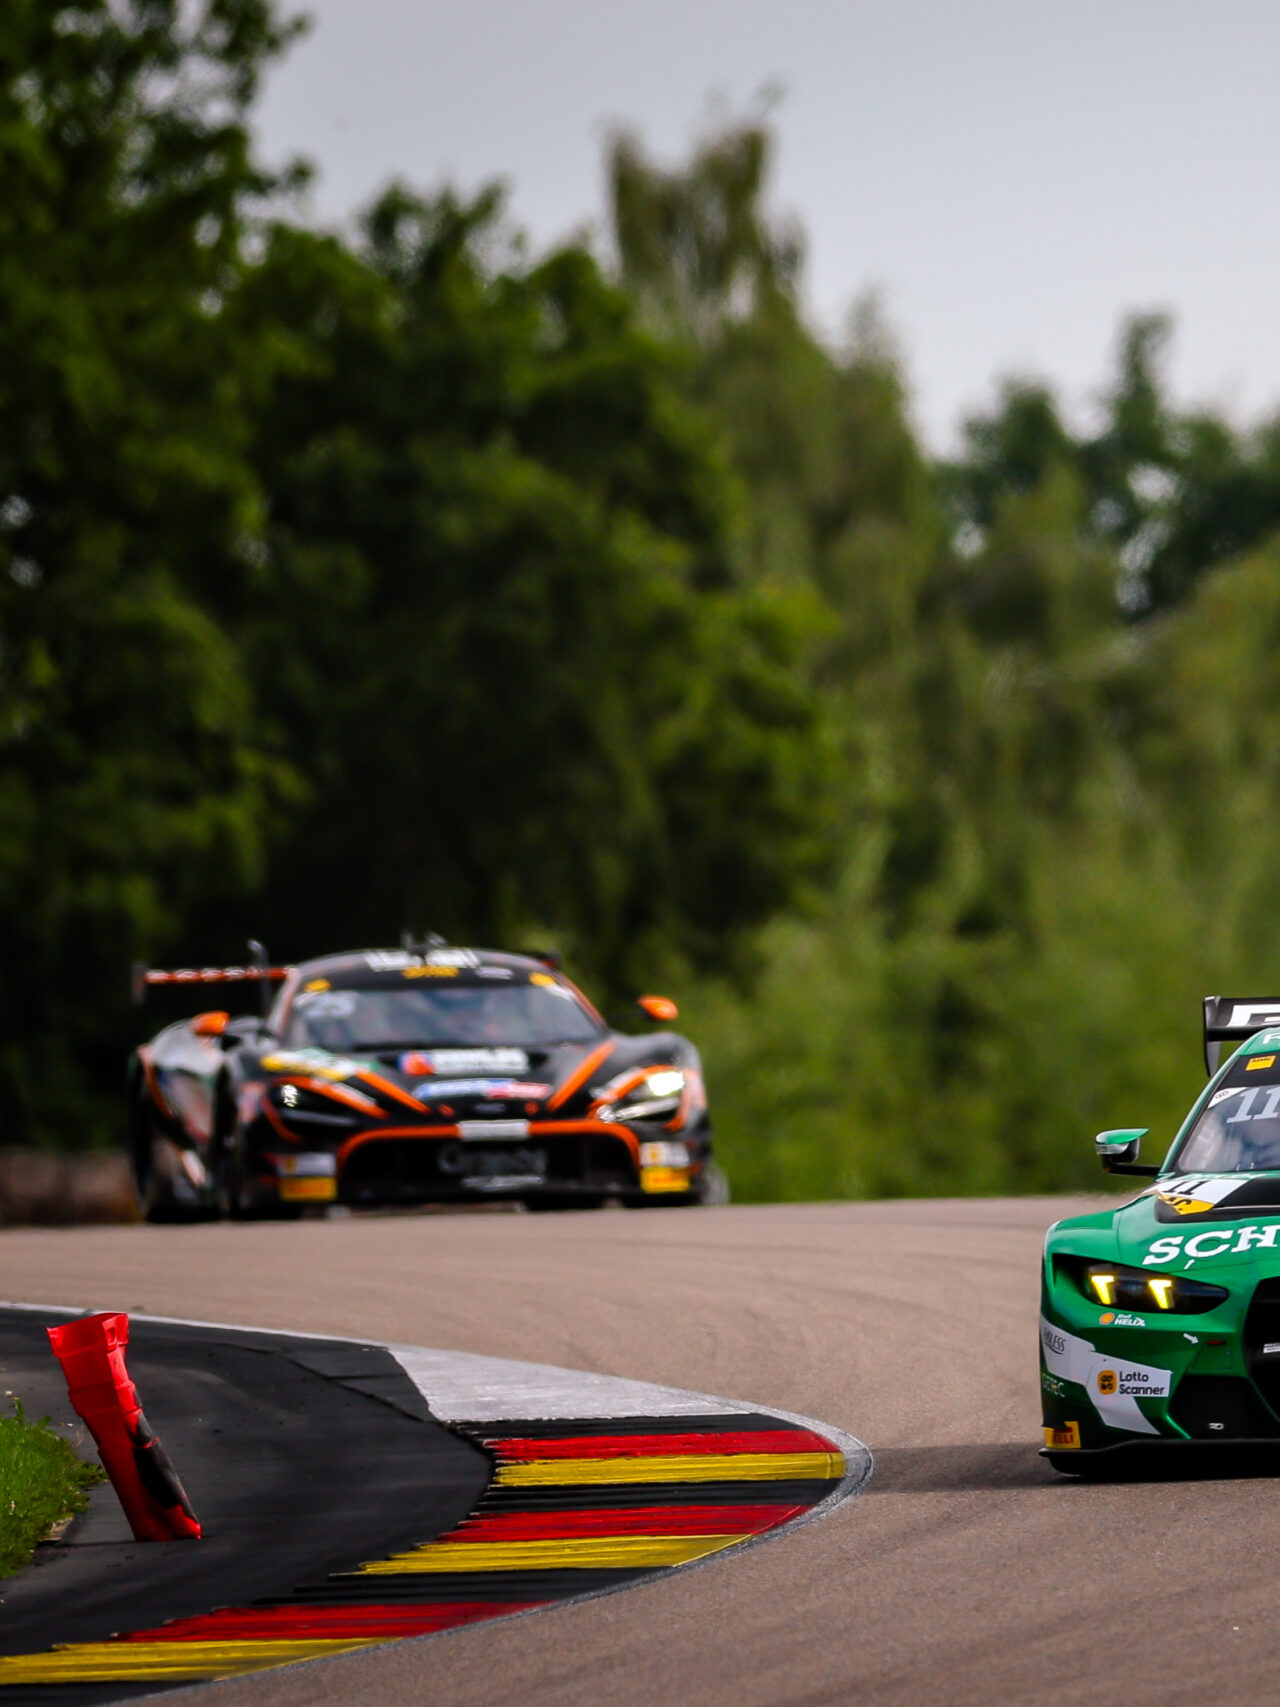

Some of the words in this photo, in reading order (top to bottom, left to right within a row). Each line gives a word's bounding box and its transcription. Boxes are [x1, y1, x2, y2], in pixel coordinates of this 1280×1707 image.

[1163, 1180, 1211, 1196] 11
[1119, 1371, 1149, 1382] Lotto
[1119, 1384, 1165, 1395] Scanner
